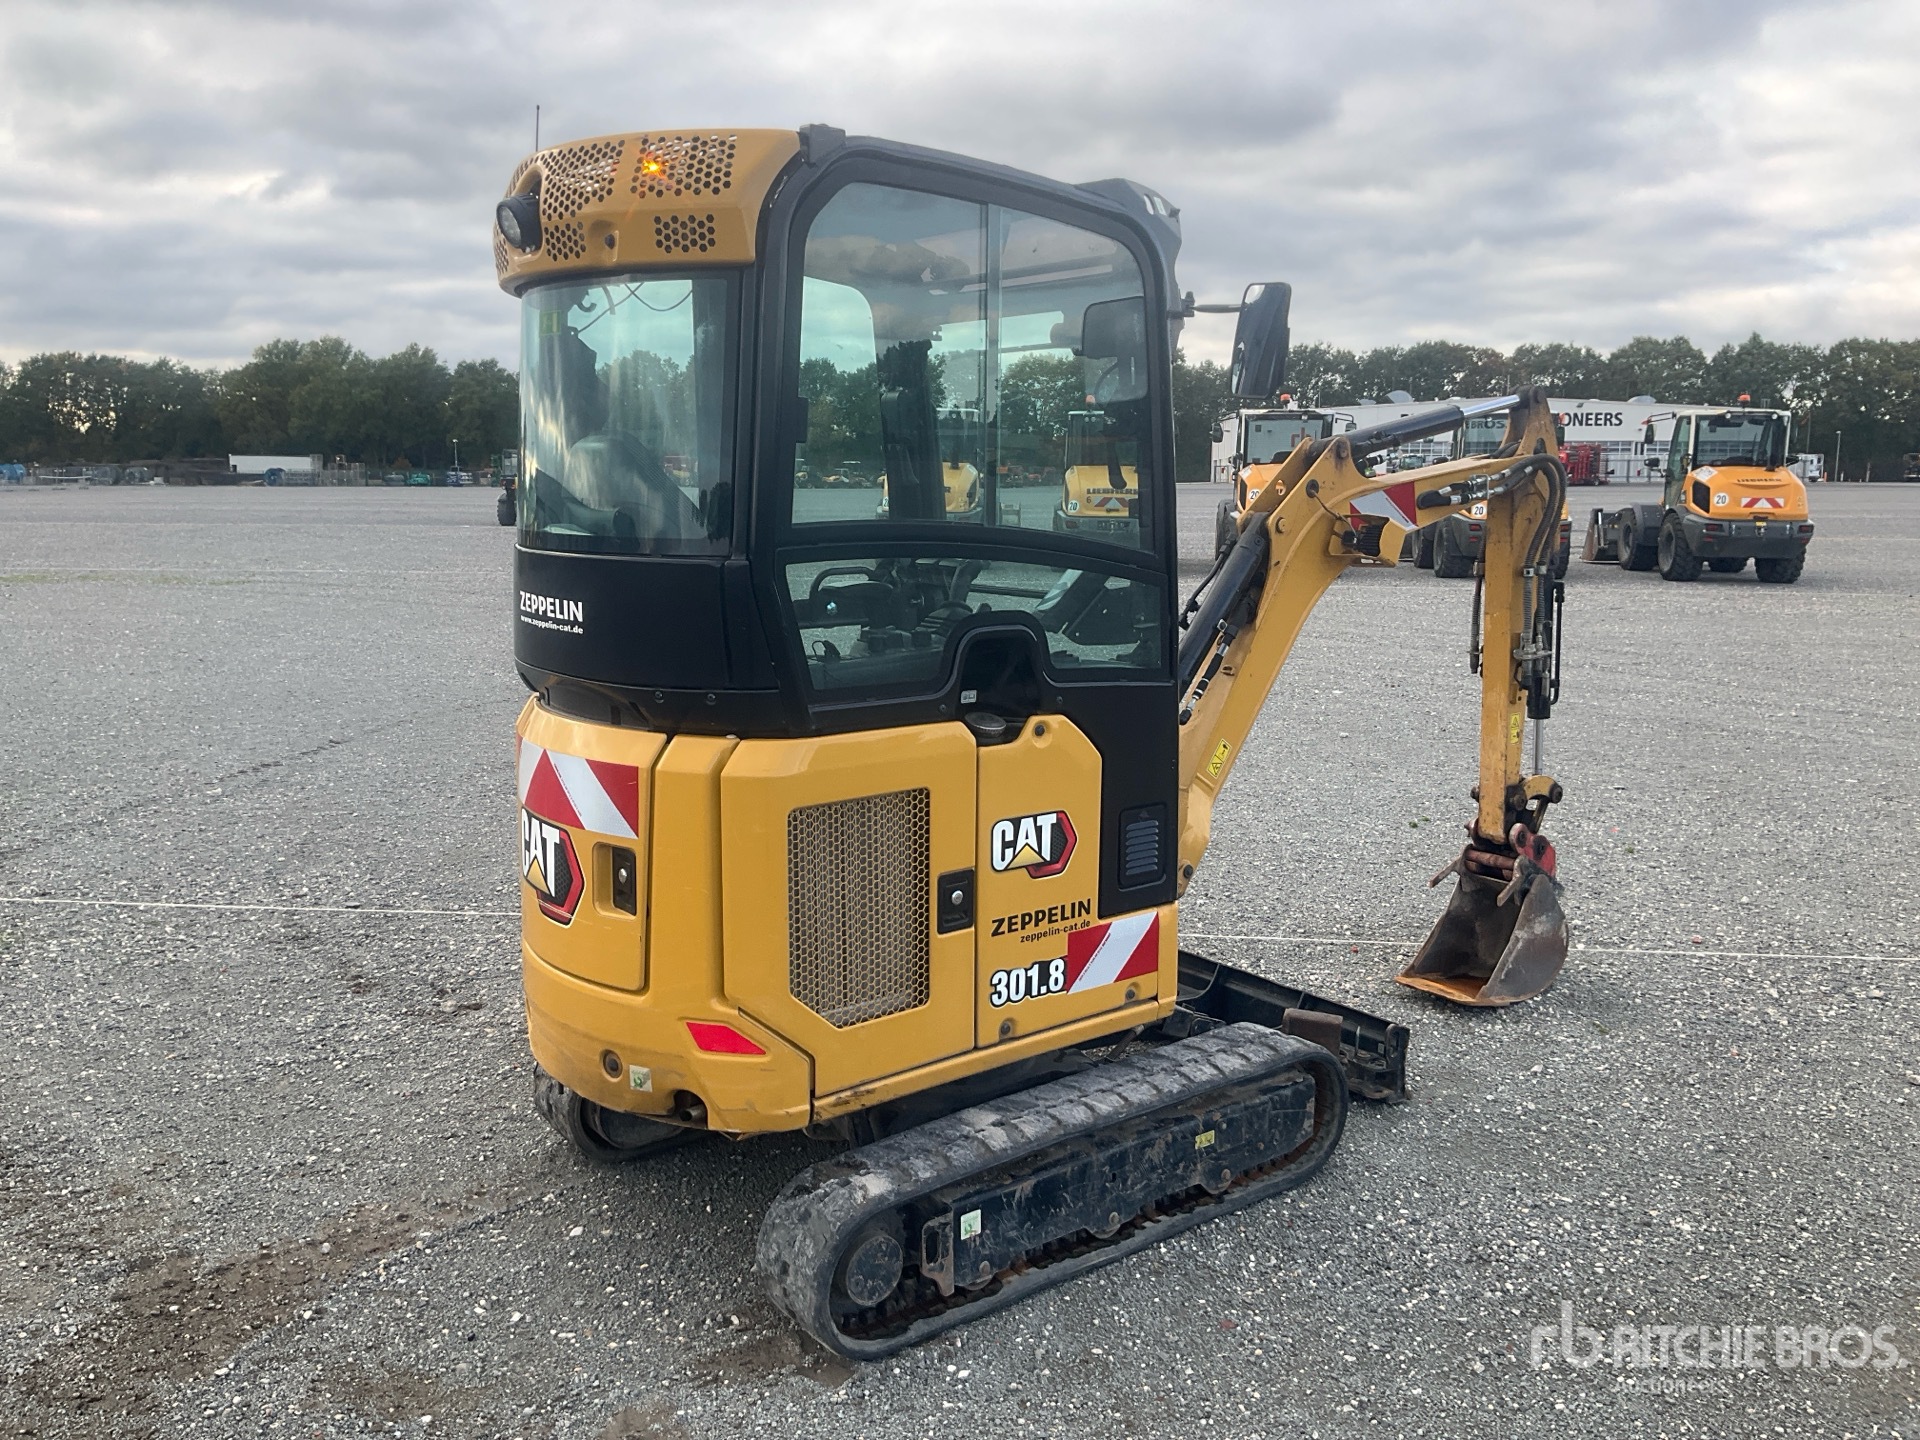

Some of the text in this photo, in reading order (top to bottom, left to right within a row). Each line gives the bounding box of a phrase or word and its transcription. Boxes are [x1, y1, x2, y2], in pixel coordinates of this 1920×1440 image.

[1069, 501, 1078, 511] 20
[1474, 505, 1484, 516] 20
[1715, 494, 1727, 505] 20
[519, 590, 584, 623] ZEPPELIN
[520, 614, 584, 635] www.zeppelin-cat.de
[521, 808, 560, 898] CAT
[992, 812, 1058, 871] CAT
[990, 898, 1092, 938] ZEPPELIN
[1019, 919, 1091, 943] zeppelin-cat.de
[990, 957, 1066, 1006] 301.8
